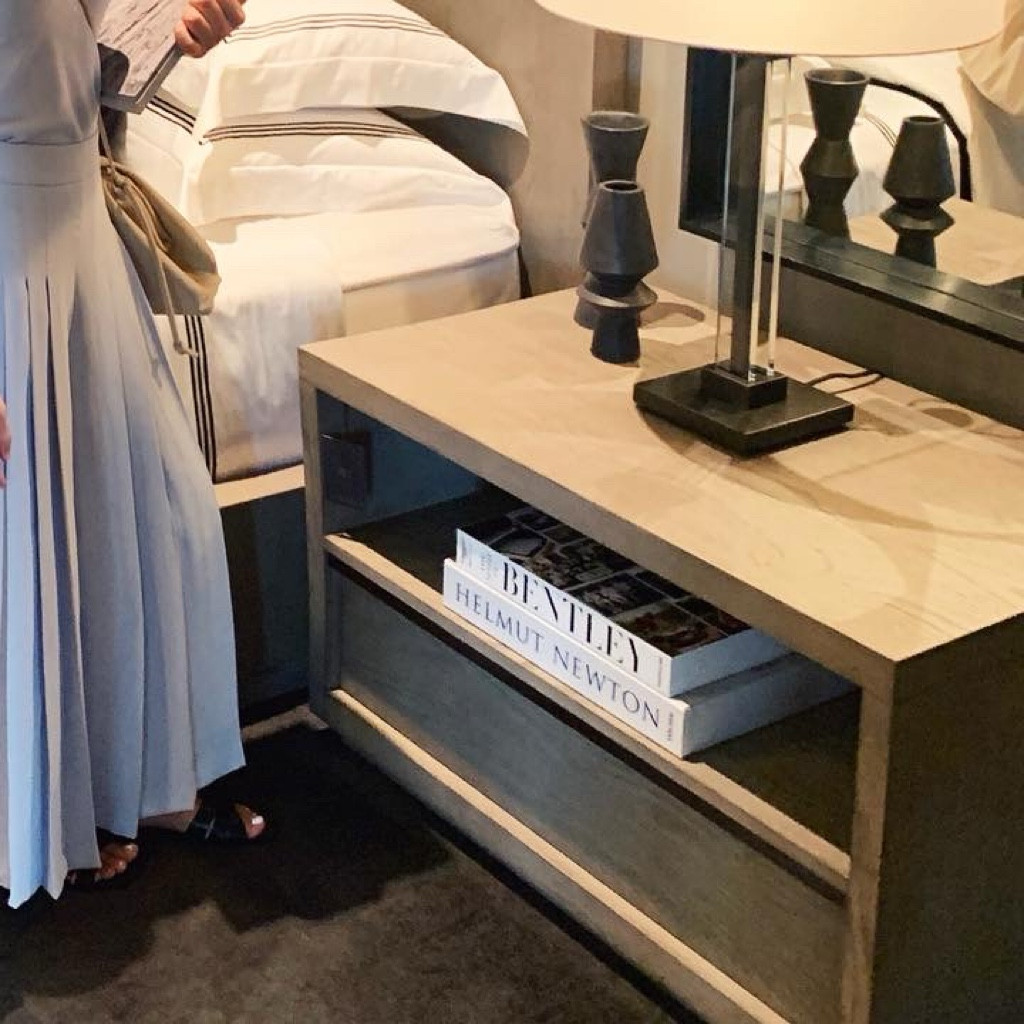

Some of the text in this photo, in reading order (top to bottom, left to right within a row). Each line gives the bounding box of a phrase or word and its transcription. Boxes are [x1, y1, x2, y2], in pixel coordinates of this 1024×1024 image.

[454, 582, 662, 729] HELMUT NEWTON
[501, 561, 640, 675] BENTLEY
